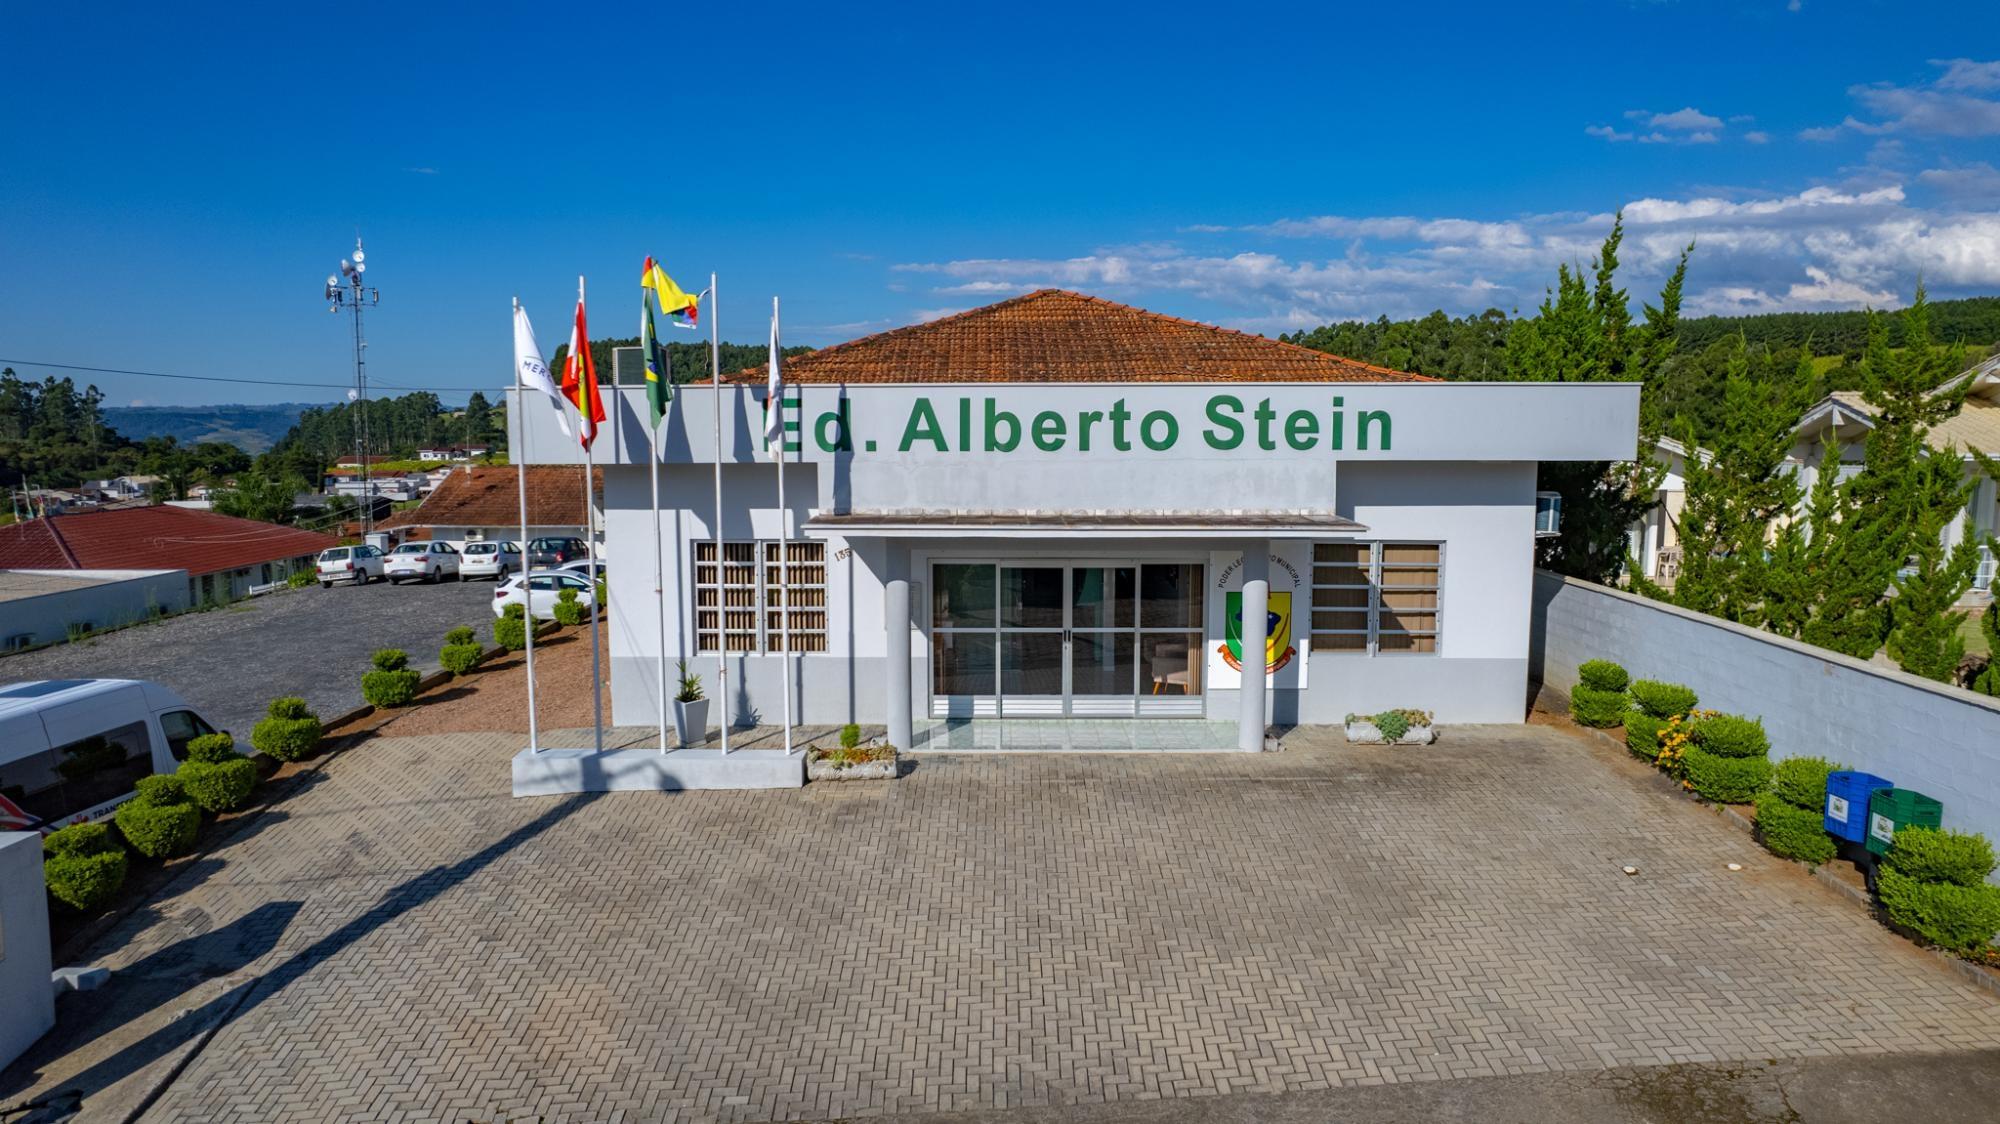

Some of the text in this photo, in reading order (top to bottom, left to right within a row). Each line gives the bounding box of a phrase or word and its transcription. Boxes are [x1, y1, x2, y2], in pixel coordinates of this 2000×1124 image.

[899, 398, 1179, 452] Alberto
[1203, 395, 1392, 451] Stein
[1218, 566, 1234, 588] PODER
[1277, 557, 1301, 588] MUNICIPAL
